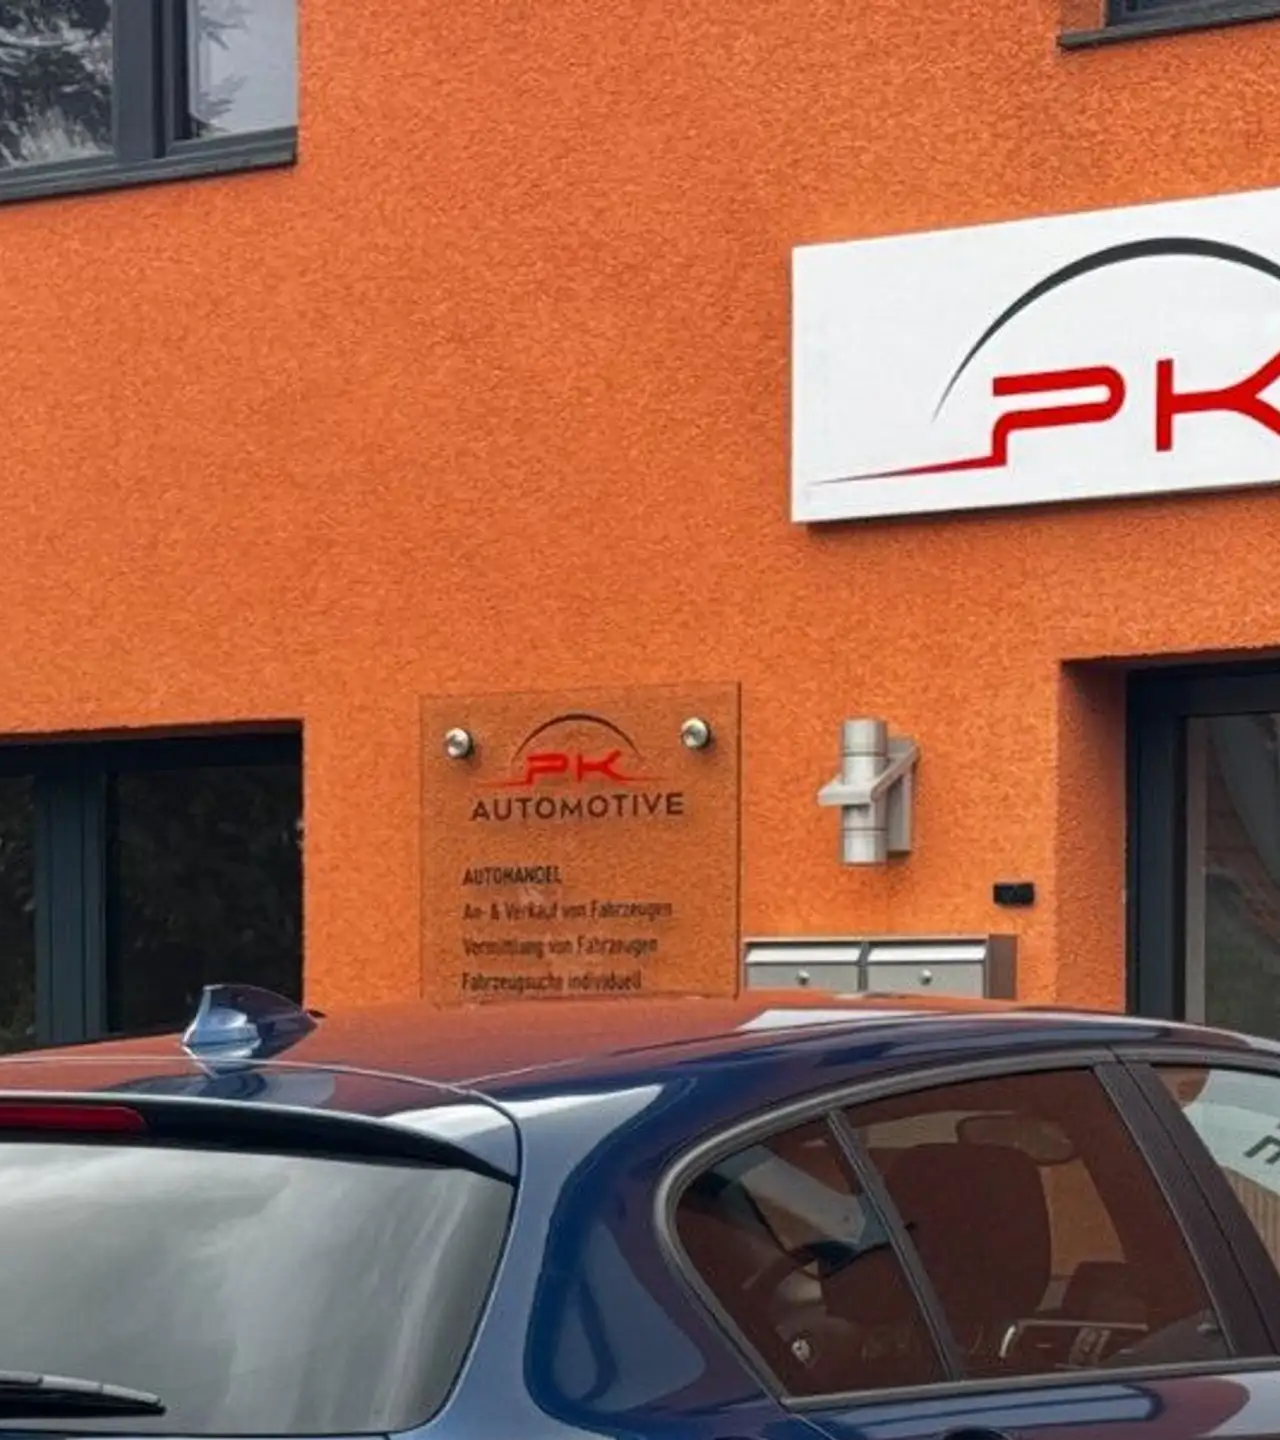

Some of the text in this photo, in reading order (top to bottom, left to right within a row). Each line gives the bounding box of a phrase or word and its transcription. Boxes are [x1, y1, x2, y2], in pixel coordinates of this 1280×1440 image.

[524, 750, 623, 785] PK
[470, 791, 685, 822] AUTOMOTIVE
[461, 865, 562, 886] AUTOHANDEL
[503, 900, 558, 921] Verkauf
[561, 904, 587, 919] von
[589, 899, 673, 923] Fahrzeugen
[548, 937, 573, 955] von
[576, 933, 659, 958] Fahrzeugen
[462, 970, 563, 994] Fahrzeugsuche
